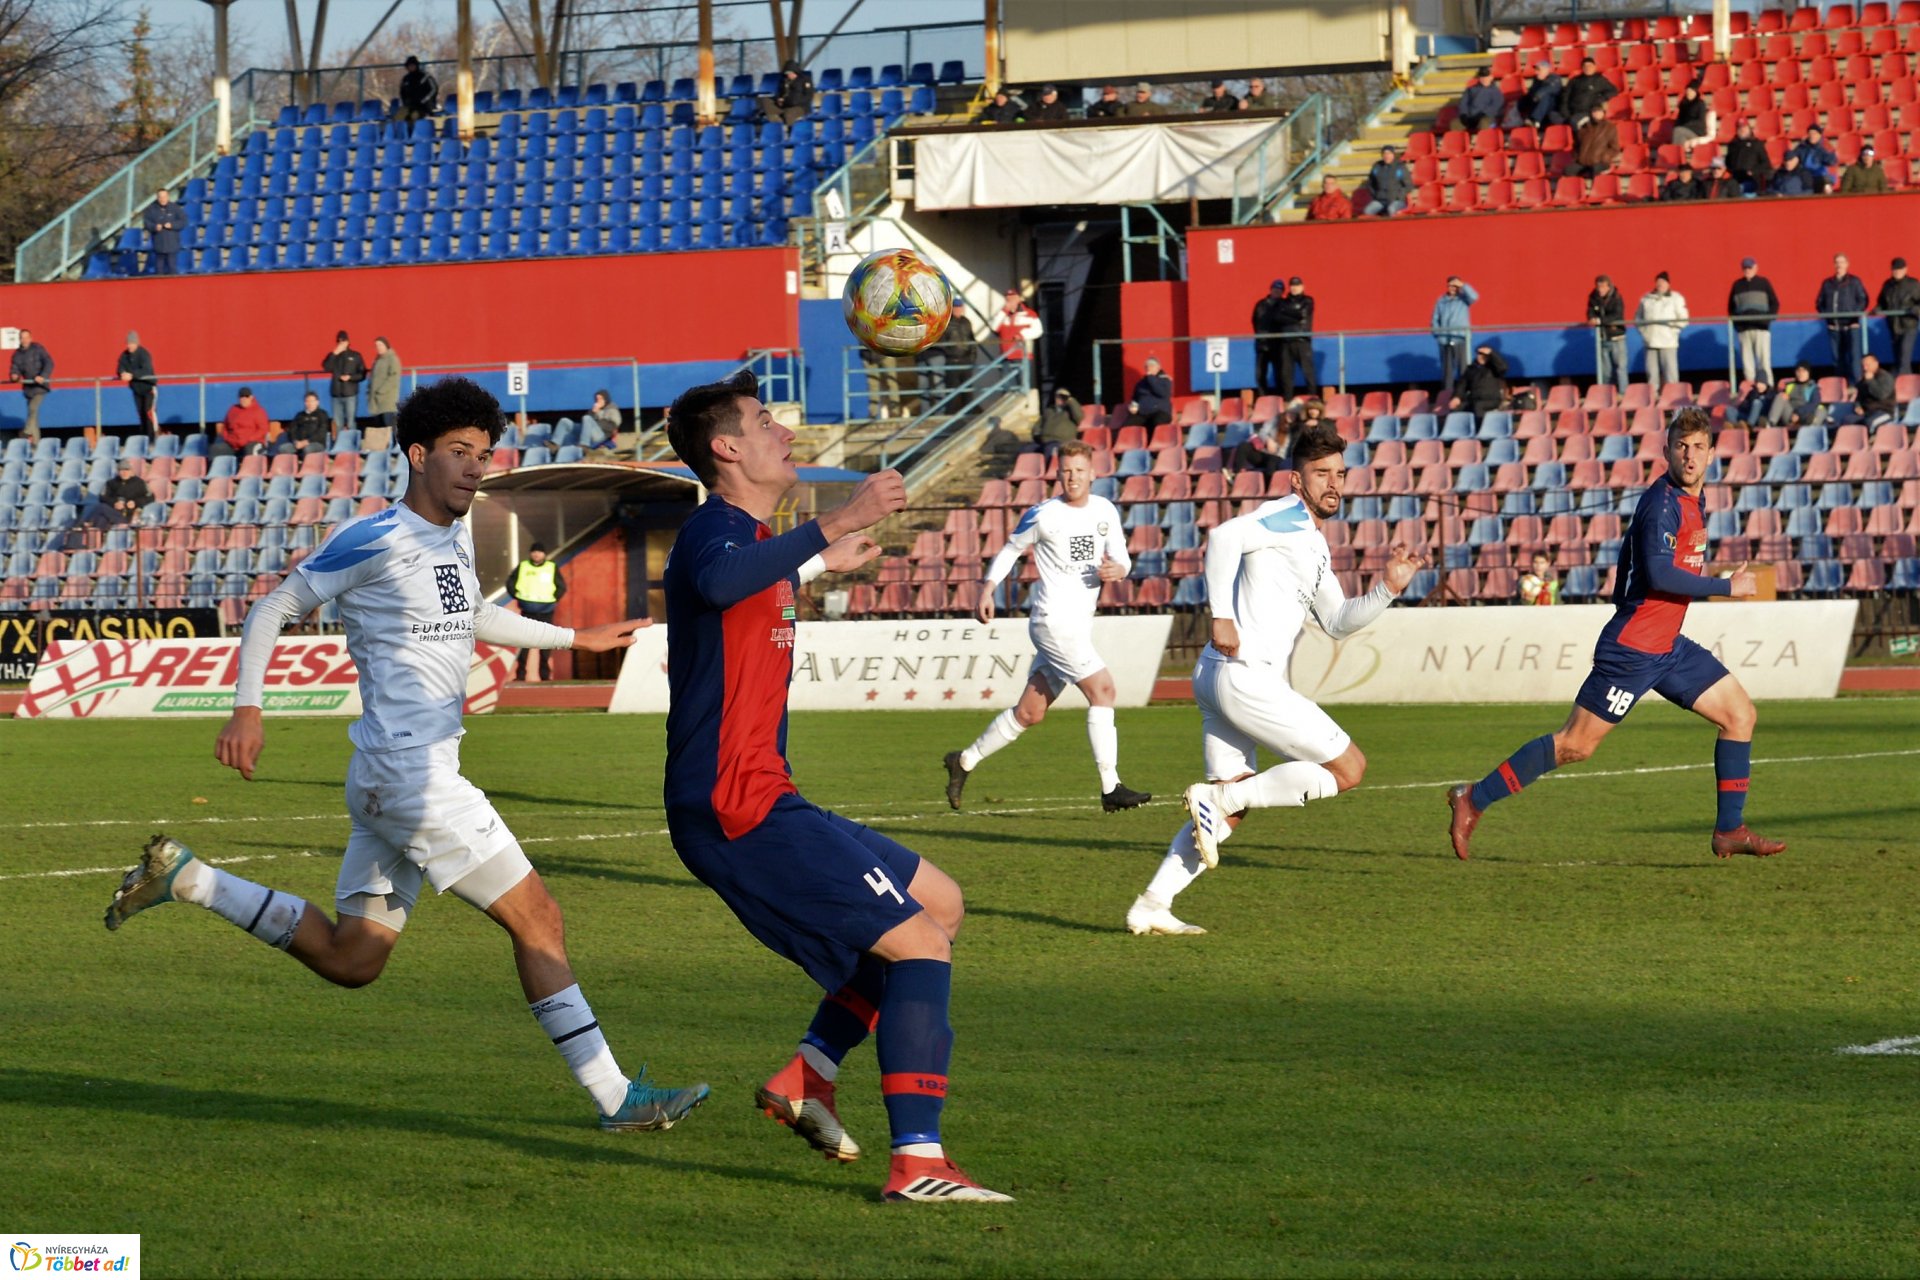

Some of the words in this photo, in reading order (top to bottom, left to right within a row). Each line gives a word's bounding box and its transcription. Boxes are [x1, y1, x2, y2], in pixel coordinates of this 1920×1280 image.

[830, 235, 842, 250] A
[1212, 352, 1223, 368] C
[514, 376, 523, 391] B
[46, 616, 196, 643] CASINO
[894, 628, 1000, 641] HOTEL
[1421, 633, 1799, 671] NYÍREÁZA
[791, 651, 1036, 682] AVENTIN
[159, 696, 215, 707] ALWAYS
[309, 694, 344, 706] WAY
[1606, 685, 1635, 716] 48
[863, 866, 905, 905] 4
